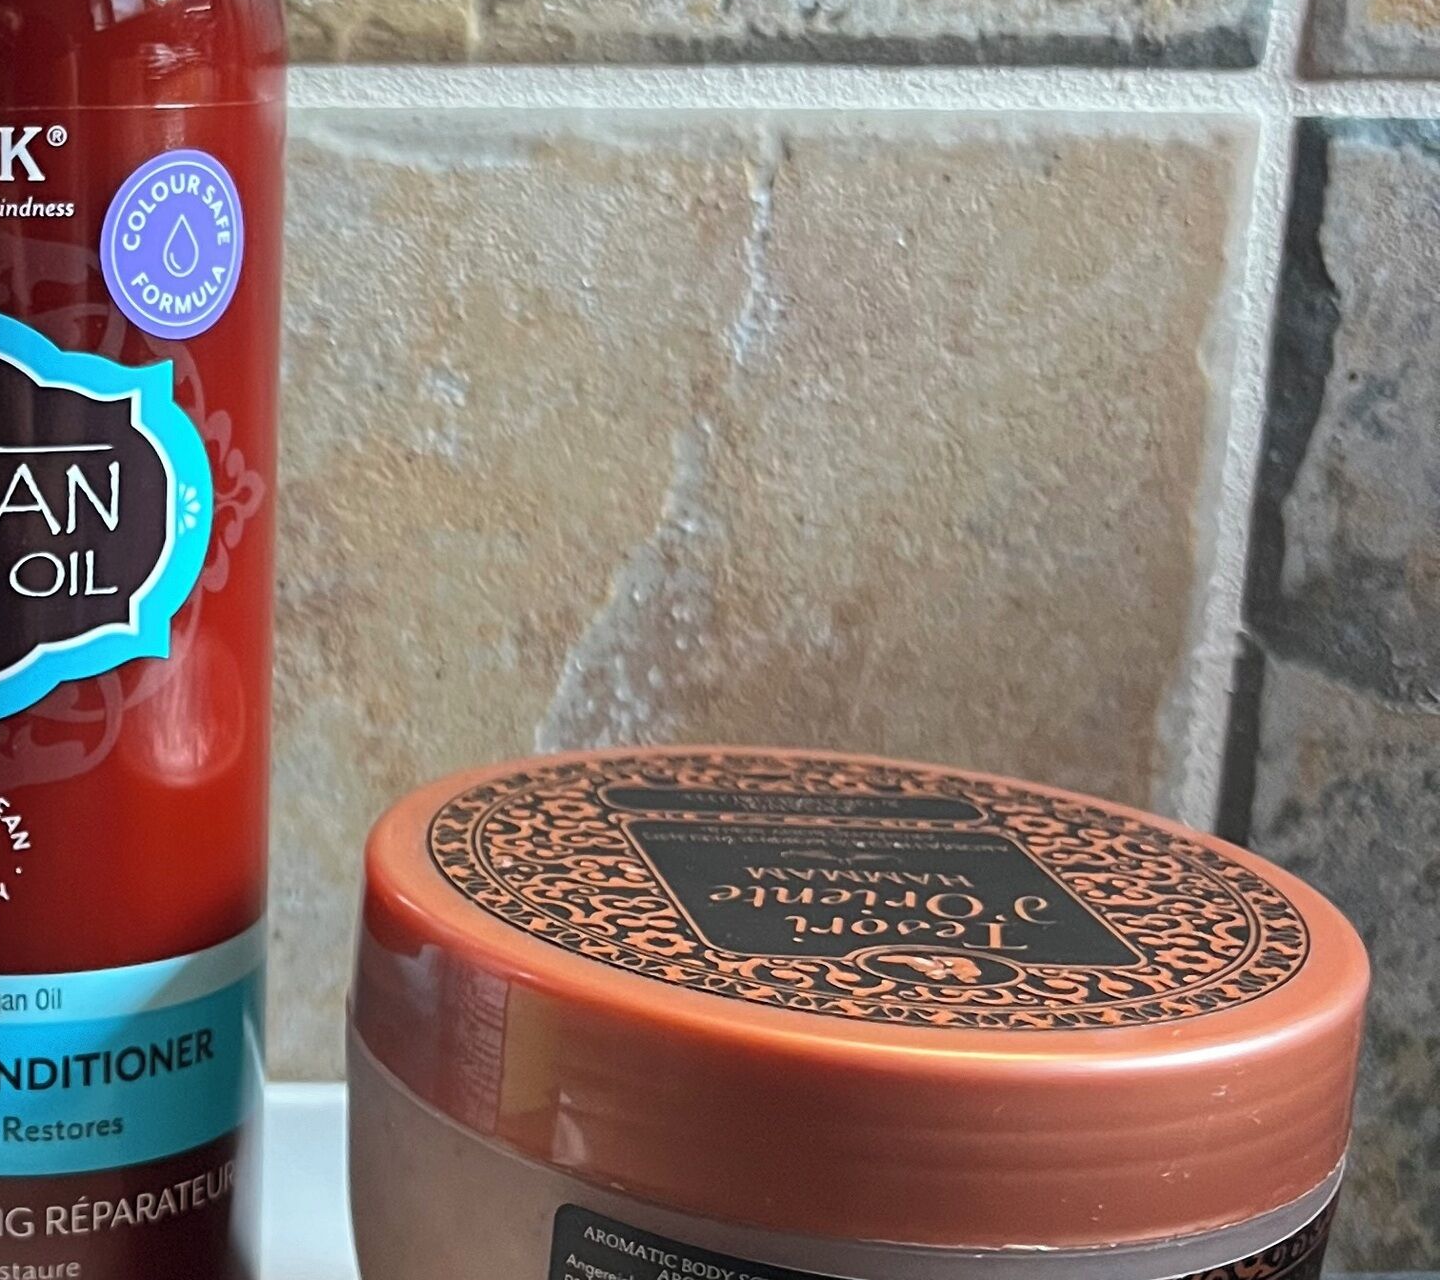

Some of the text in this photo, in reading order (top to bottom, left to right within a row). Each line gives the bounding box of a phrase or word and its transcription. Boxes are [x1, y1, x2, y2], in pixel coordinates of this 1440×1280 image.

[122, 173, 230, 251] COLOUR SAFE
[131, 267, 225, 314] FORMULA
[9, 550, 118, 597] OIL
[745, 866, 976, 890] HAMMAM
[785, 914, 1030, 952] Tesori
[35, 987, 62, 1010] Oil
[3, 1116, 123, 1142] Restores
[45, 1161, 235, 1237] RÉPARATEUR
[584, 1226, 678, 1269] AROMATIC
